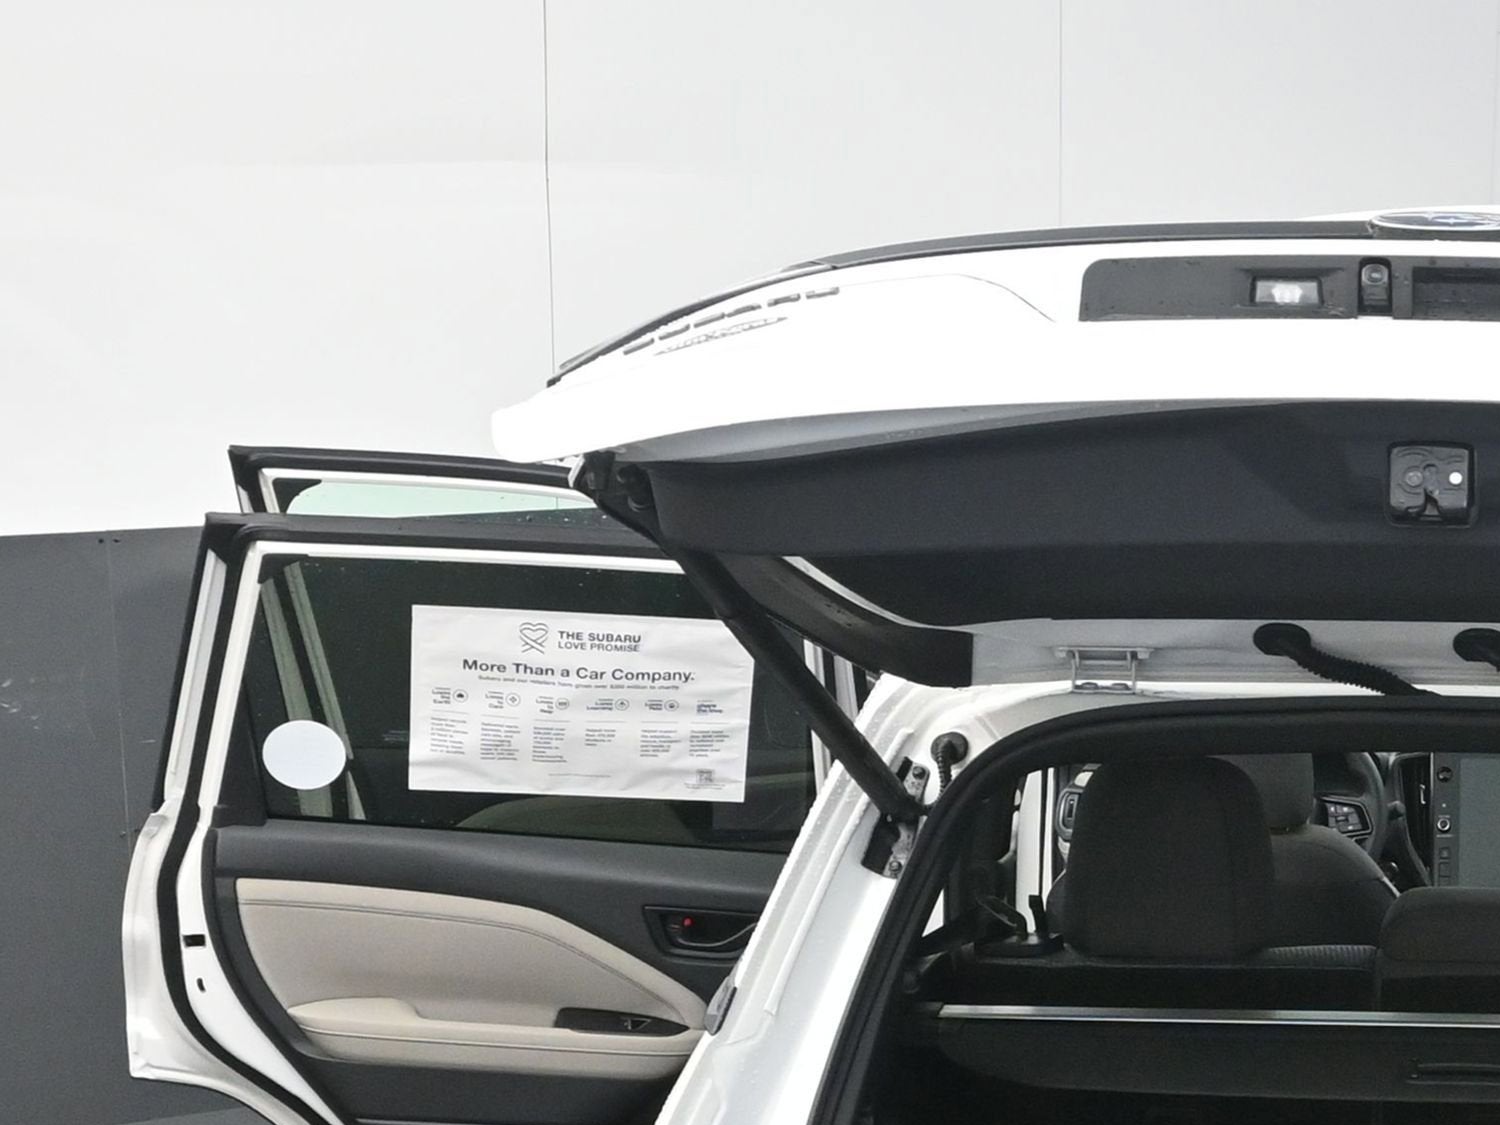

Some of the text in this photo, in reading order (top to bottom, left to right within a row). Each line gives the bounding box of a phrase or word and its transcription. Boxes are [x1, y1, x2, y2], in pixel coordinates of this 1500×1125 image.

[558, 630, 643, 644] THE SUBARU
[558, 641, 641, 653] LOVE PROMISE
[462, 658, 507, 674] More
[512, 662, 555, 678] Than
[560, 668, 571, 678] a
[576, 666, 607, 682] Car
